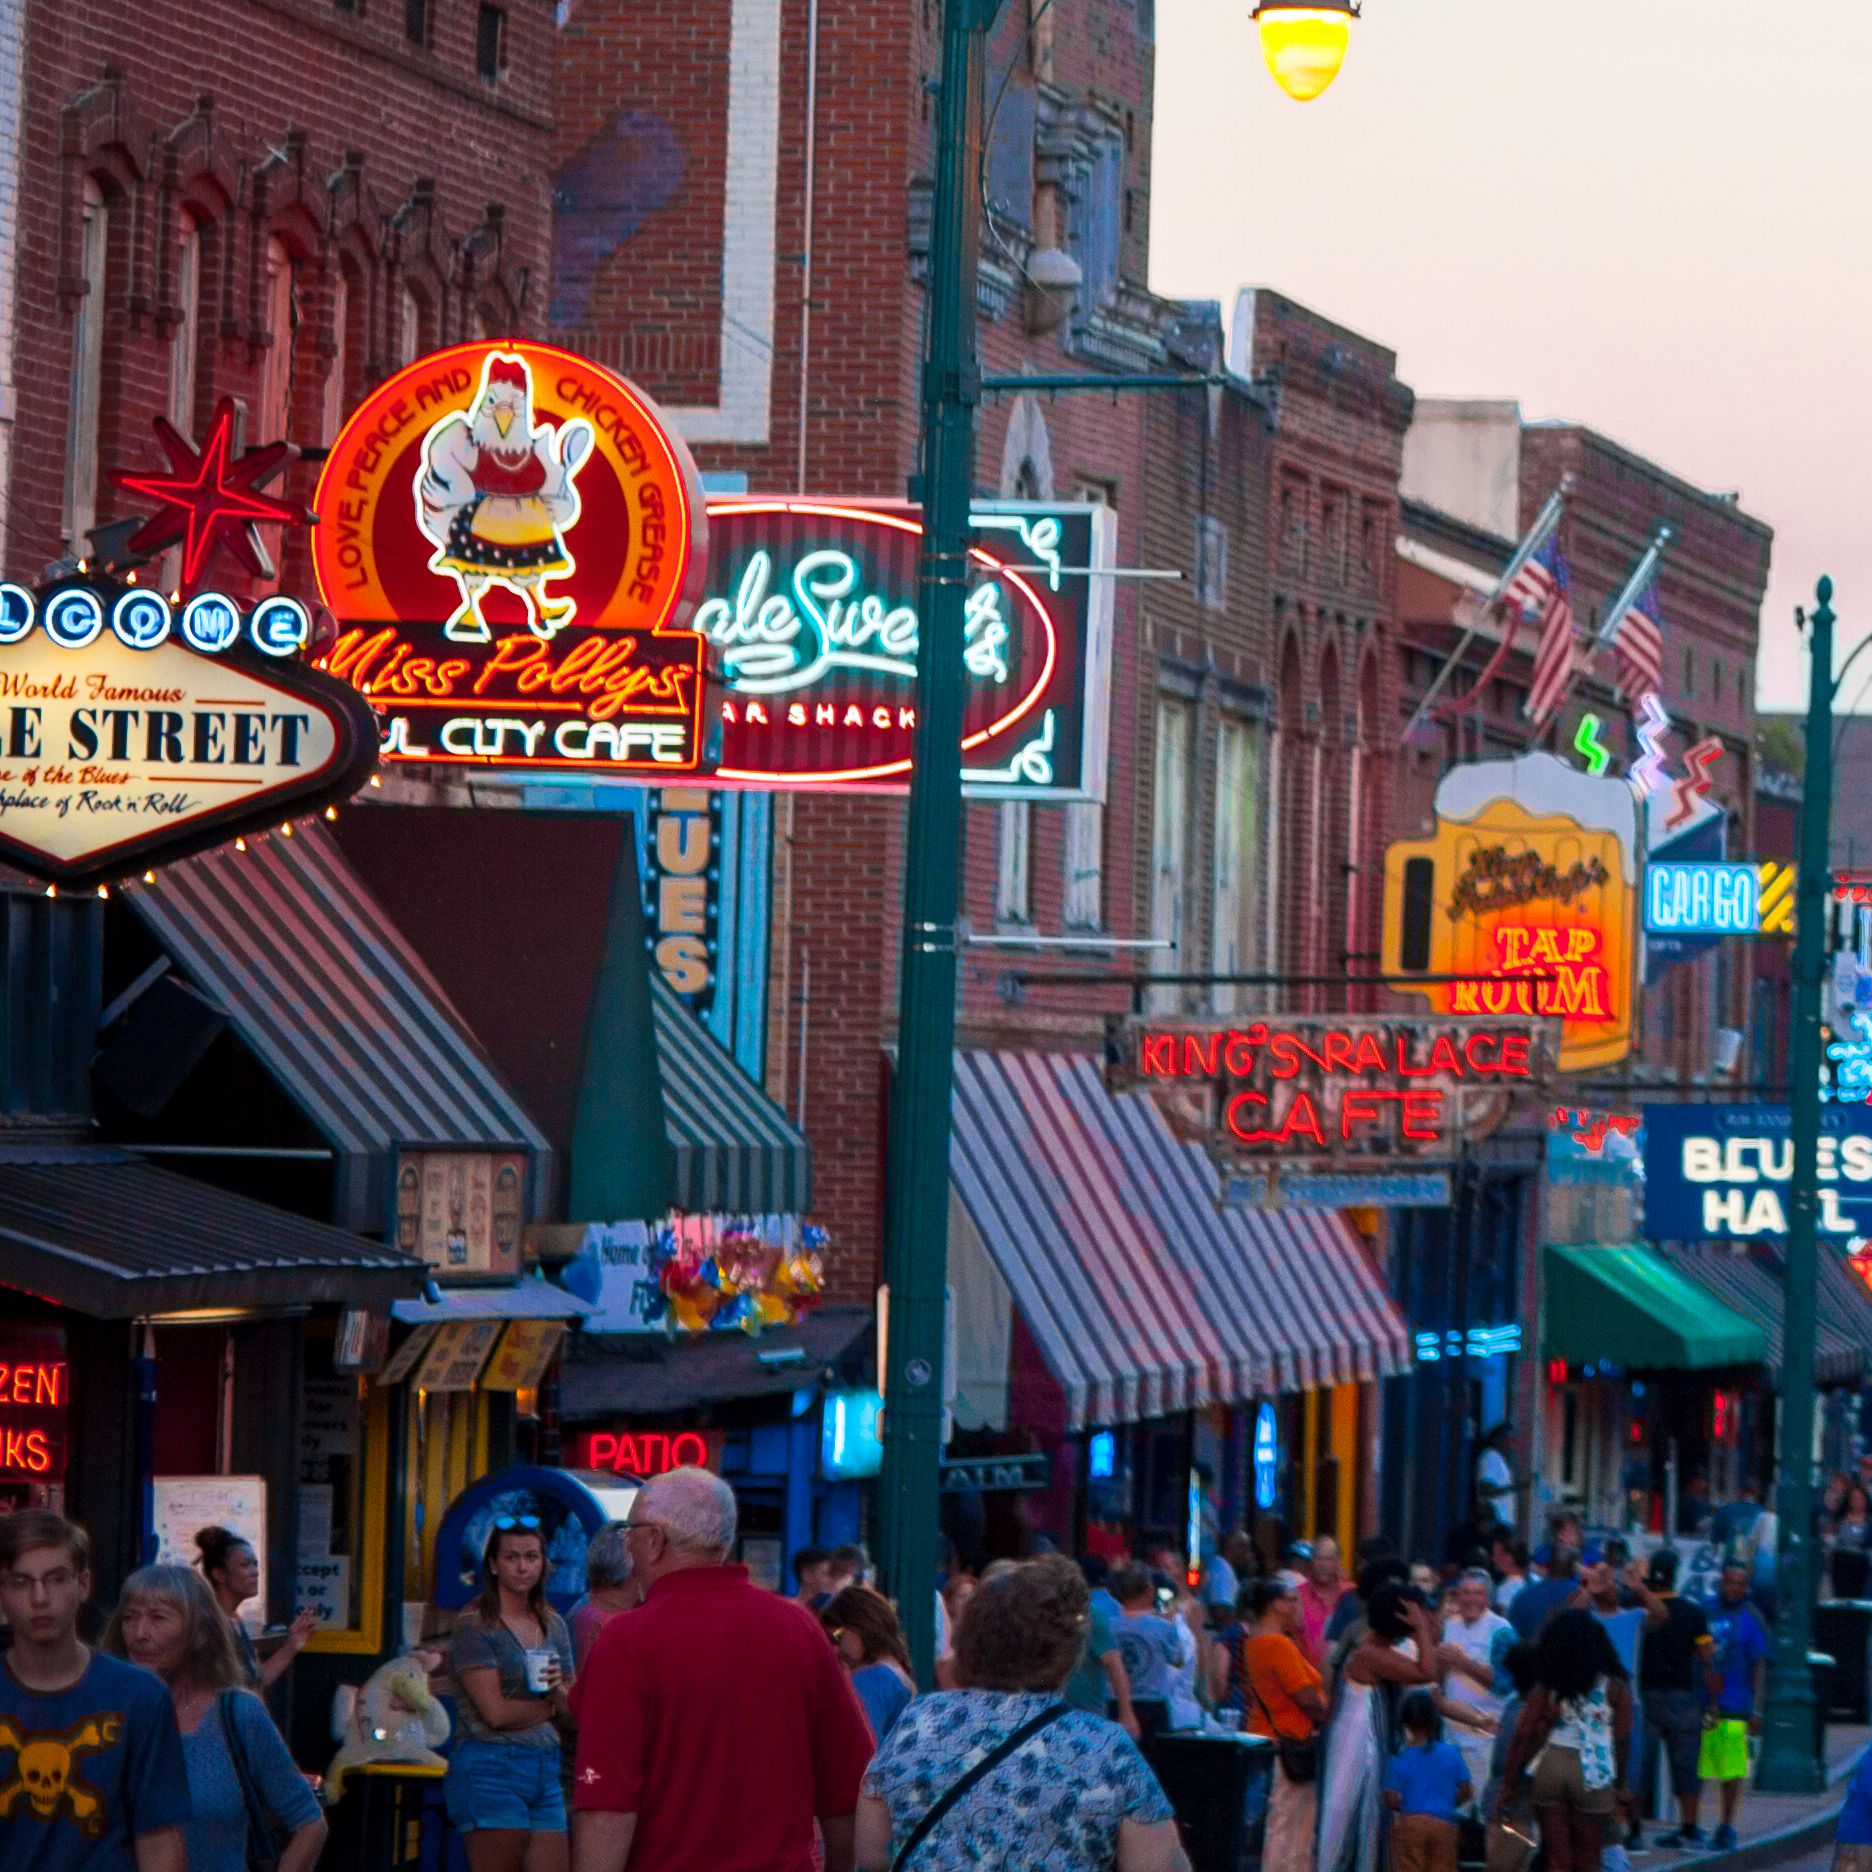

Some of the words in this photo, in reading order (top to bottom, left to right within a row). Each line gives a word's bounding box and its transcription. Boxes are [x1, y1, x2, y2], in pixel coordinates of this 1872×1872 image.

[344, 400, 412, 500] PEACE
[415, 367, 473, 412] AND
[555, 375, 653, 478] CHICKEN
[627, 479, 667, 605] GREASE
[328, 628, 470, 695] Miss
[0, 672, 77, 700] World
[86, 673, 186, 702] Famous
[0, 706, 43, 759] E
[68, 707, 309, 767] STREET
[788, 702, 916, 728] SHACK
[441, 717, 547, 758] CITY
[554, 720, 687, 763] CAFE
[23, 765, 39, 787] of
[43, 765, 74, 784] the
[77, 765, 131, 785] Blues
[55, 793, 71, 818] of
[76, 790, 122, 814] Rock
[143, 792, 190, 815] Roll
[1650, 866, 1754, 929] CARGO
[1497, 927, 1597, 970] TAP
[1141, 1024, 1302, 1079] KING'S
[1227, 1089, 1445, 1145] CAFE
[1703, 1188, 1857, 1235] HAL
[0, 1426, 50, 1472] KS
[590, 1432, 706, 1474] PATIO
